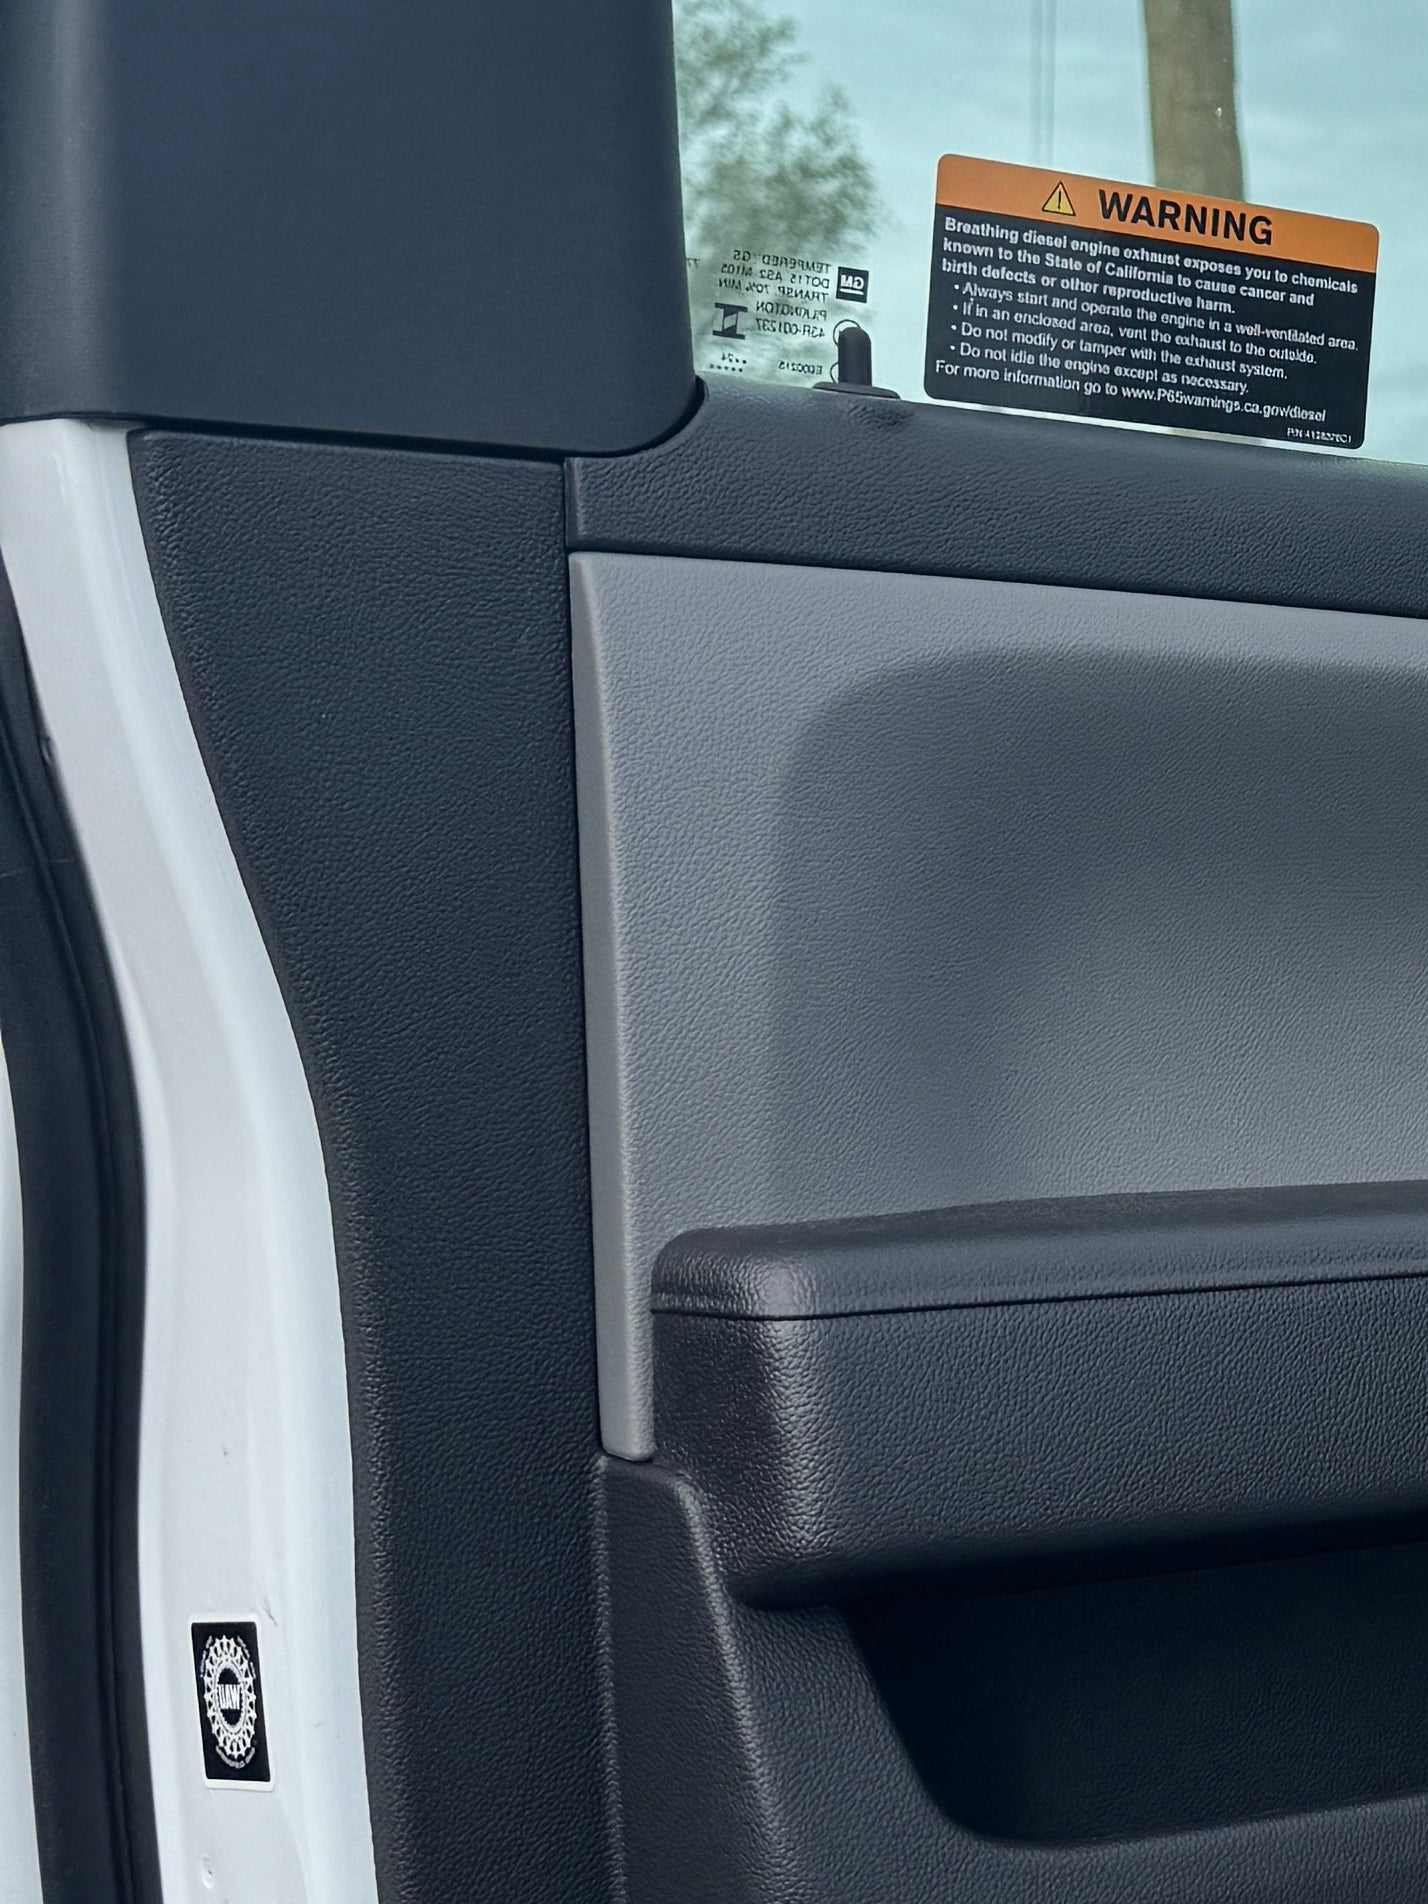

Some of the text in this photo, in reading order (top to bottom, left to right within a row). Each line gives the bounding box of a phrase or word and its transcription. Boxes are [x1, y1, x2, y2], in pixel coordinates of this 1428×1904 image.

[1097, 188, 1274, 246] WARNING
[942, 236, 1315, 306] known to the State of California to cause cancer and
[944, 215, 1358, 294] Breathing diesel engine exhaust exposes you to chemicals
[941, 256, 1236, 314] birth defects or other reproductive harm.
[961, 281, 1358, 351] Always start and operate the engine in a well-ventilated area.
[974, 302, 989, 319] in
[991, 308, 1011, 321] an
[1012, 311, 1077, 331] enclosed
[1078, 320, 1114, 338] area,
[1117, 326, 1147, 341] vent
[1150, 328, 1172, 344] the
[1174, 333, 1227, 352] exhaust
[1229, 339, 1242, 353] to
[1245, 342, 1266, 357] the
[934, 358, 961, 376] For
[962, 365, 1000, 381] more
[1003, 366, 1080, 392] information
[1083, 380, 1102, 395] go
[1104, 381, 1118, 396] to
[959, 341, 1249, 396] Do not idle the engine except as necessary.
[960, 320, 1288, 380] Do not modify or tamper with the exhaust system.
[219, 1684, 242, 1709] UAW
